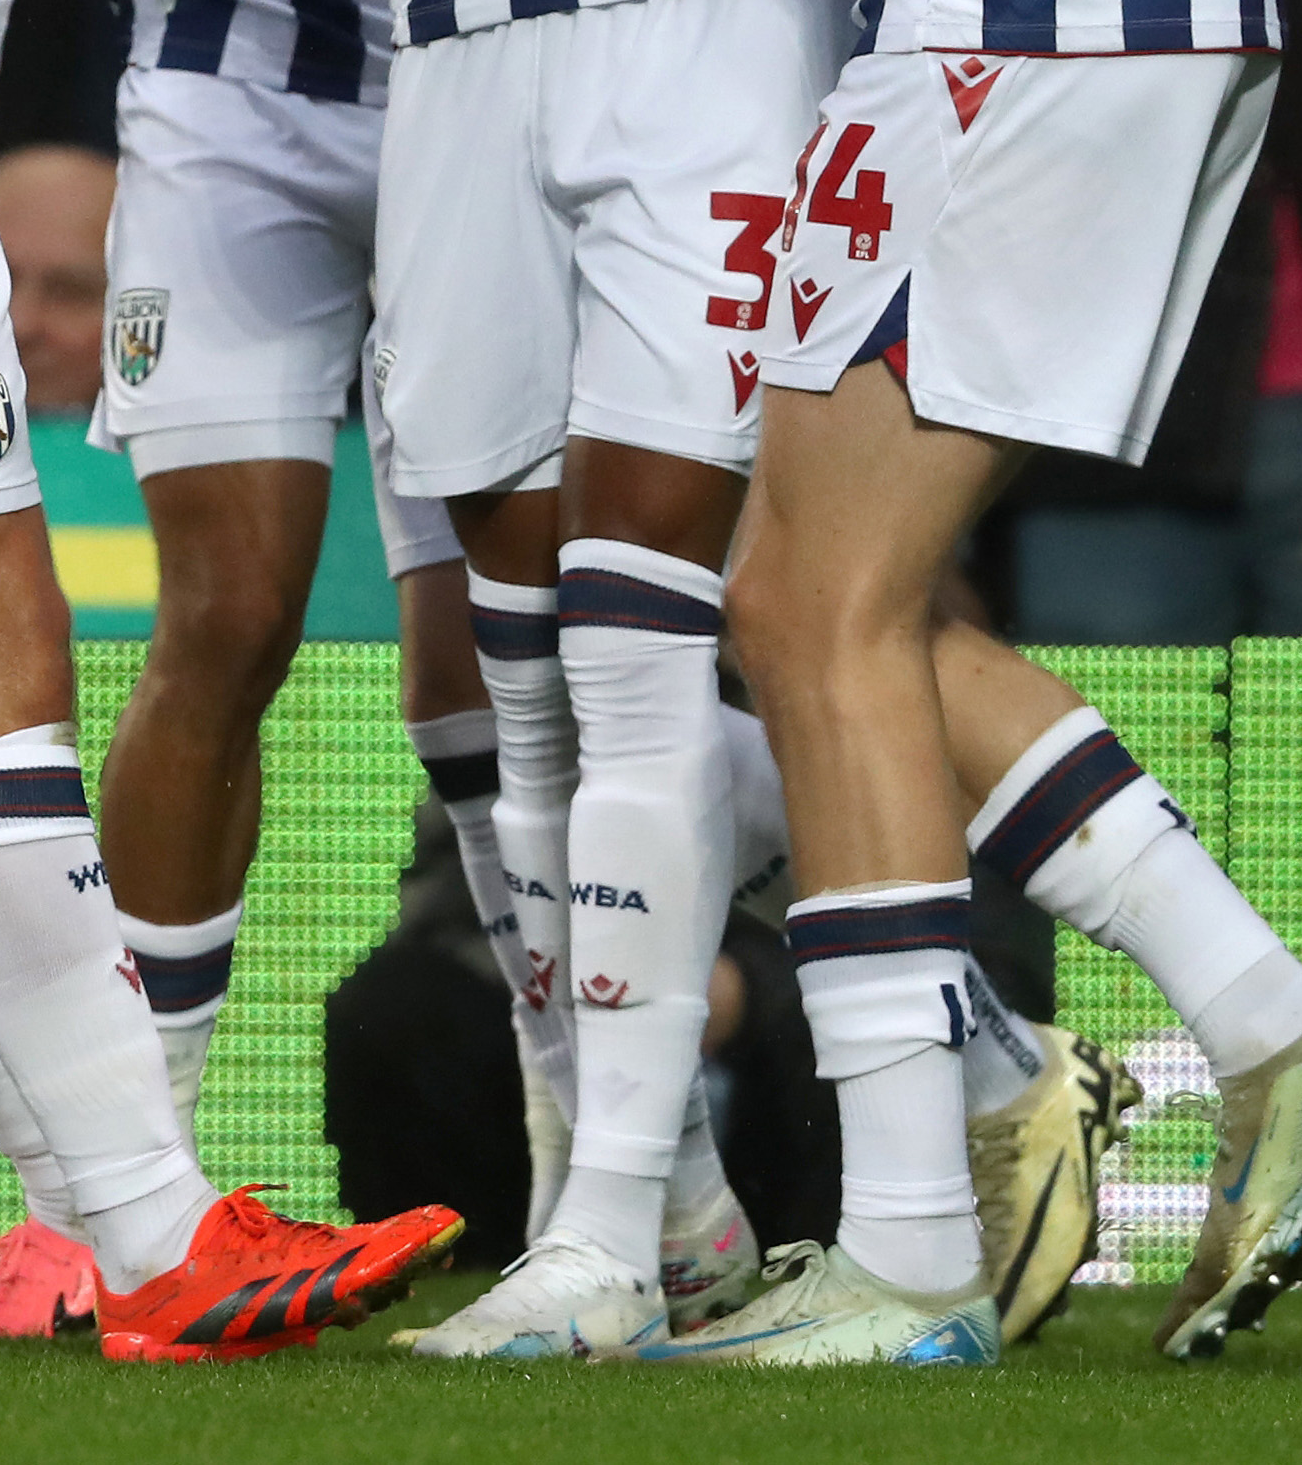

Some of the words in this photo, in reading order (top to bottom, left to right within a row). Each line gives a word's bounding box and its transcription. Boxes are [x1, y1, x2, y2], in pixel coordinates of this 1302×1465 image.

[705, 190, 786, 331] 3
[782, 120, 893, 261] 14
[569, 883, 650, 914] WBA
